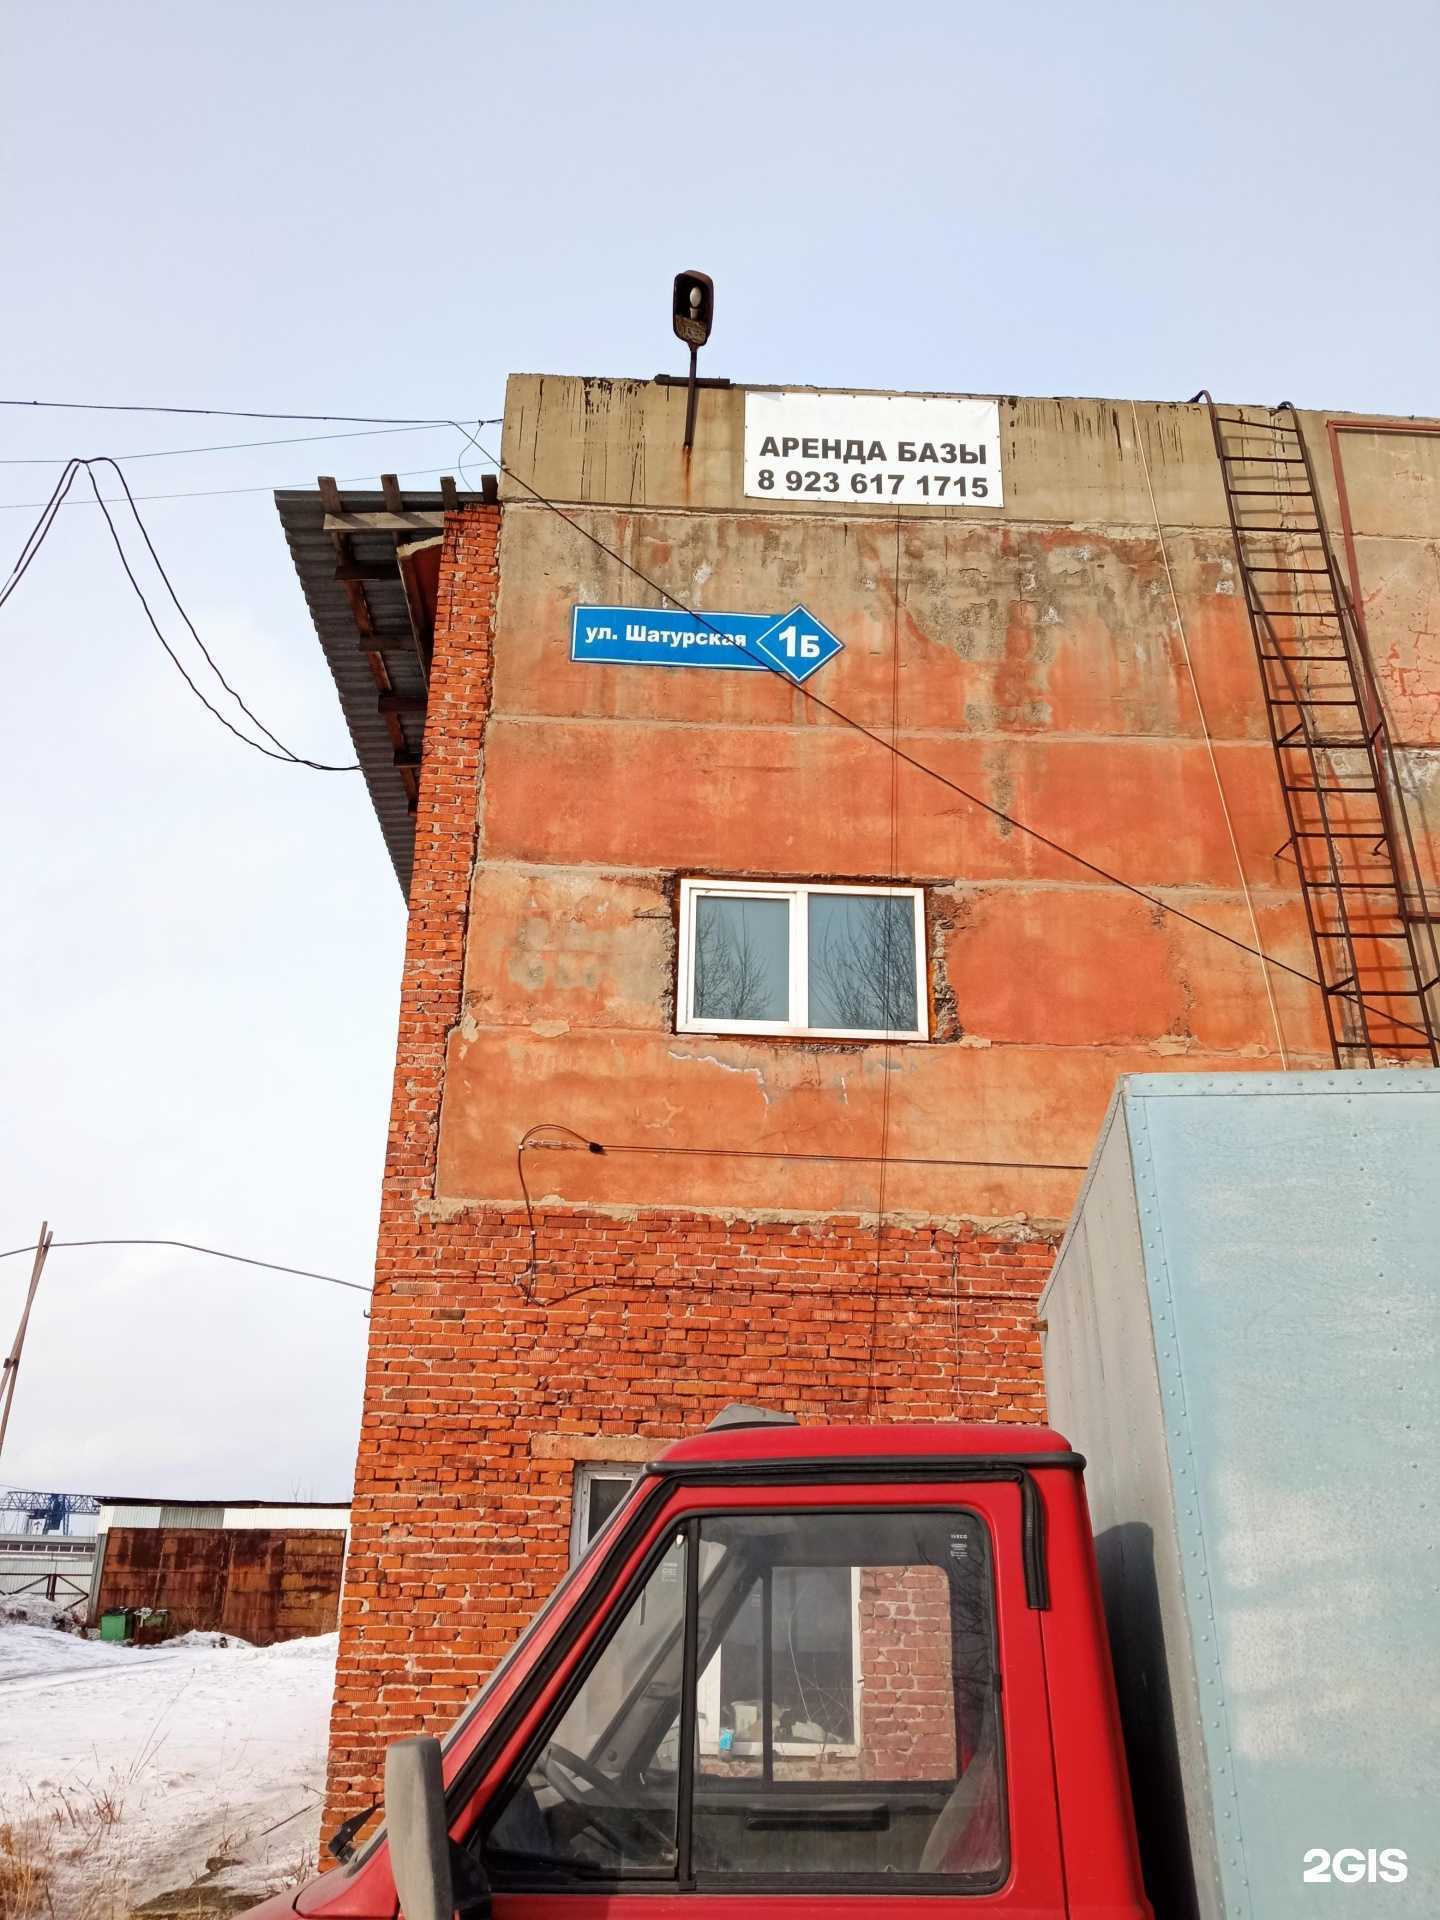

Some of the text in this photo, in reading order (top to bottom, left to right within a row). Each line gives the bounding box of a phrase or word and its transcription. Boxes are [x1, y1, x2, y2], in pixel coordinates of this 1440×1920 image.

[759, 436, 987, 465] АРЕНДА БАЗЫ
[757, 469, 989, 498] 8 923 617 1715
[585, 624, 820, 658] ул. Шатурская 1Б
